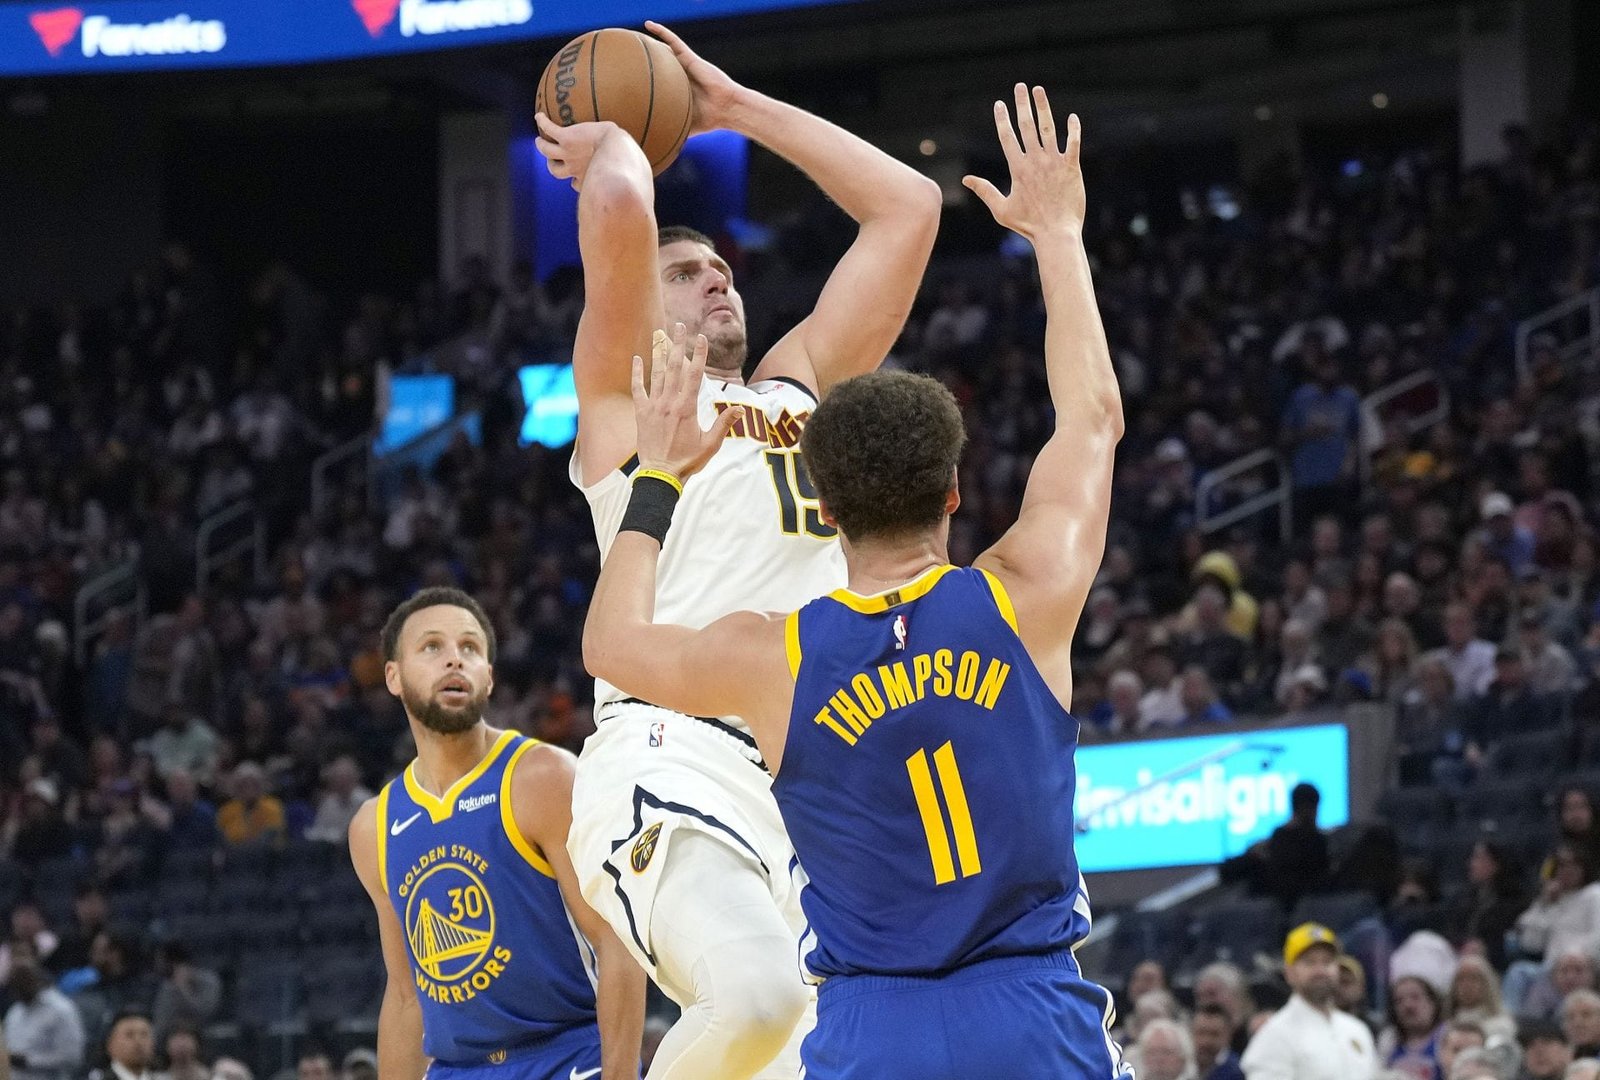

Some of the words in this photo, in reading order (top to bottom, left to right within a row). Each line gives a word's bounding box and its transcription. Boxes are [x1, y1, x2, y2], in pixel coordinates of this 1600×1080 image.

[81, 13, 227, 57] Fanatics
[763, 449, 840, 541] 15
[813, 648, 1011, 747] THOMPSON
[458, 793, 497, 812] Rakuten
[905, 739, 982, 886] 11
[1076, 762, 1286, 834] invisalign
[398, 844, 447, 898] GOLDEN
[450, 844, 489, 876] STATE
[446, 884, 484, 923] 30
[414, 944, 512, 1004] WARRIORS
